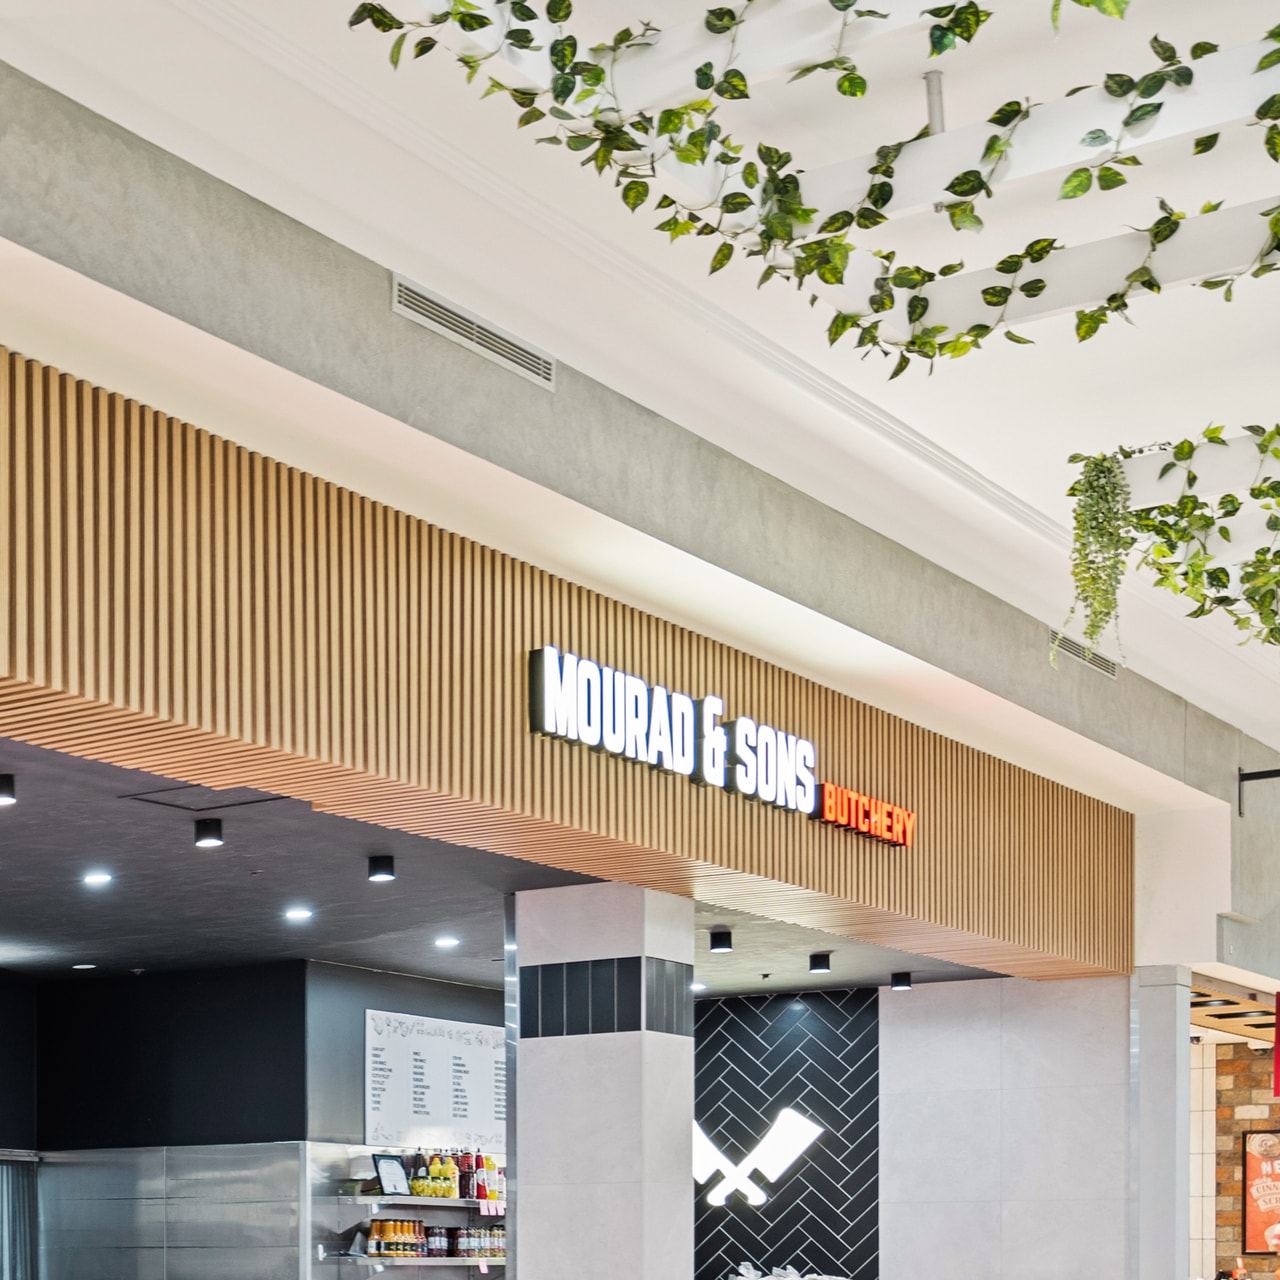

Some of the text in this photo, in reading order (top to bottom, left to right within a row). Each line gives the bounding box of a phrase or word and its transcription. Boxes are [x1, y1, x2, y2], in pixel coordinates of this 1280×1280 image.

[542, 645, 816, 814] MOURAD & SONS
[823, 781, 916, 848] BUTCHERY
